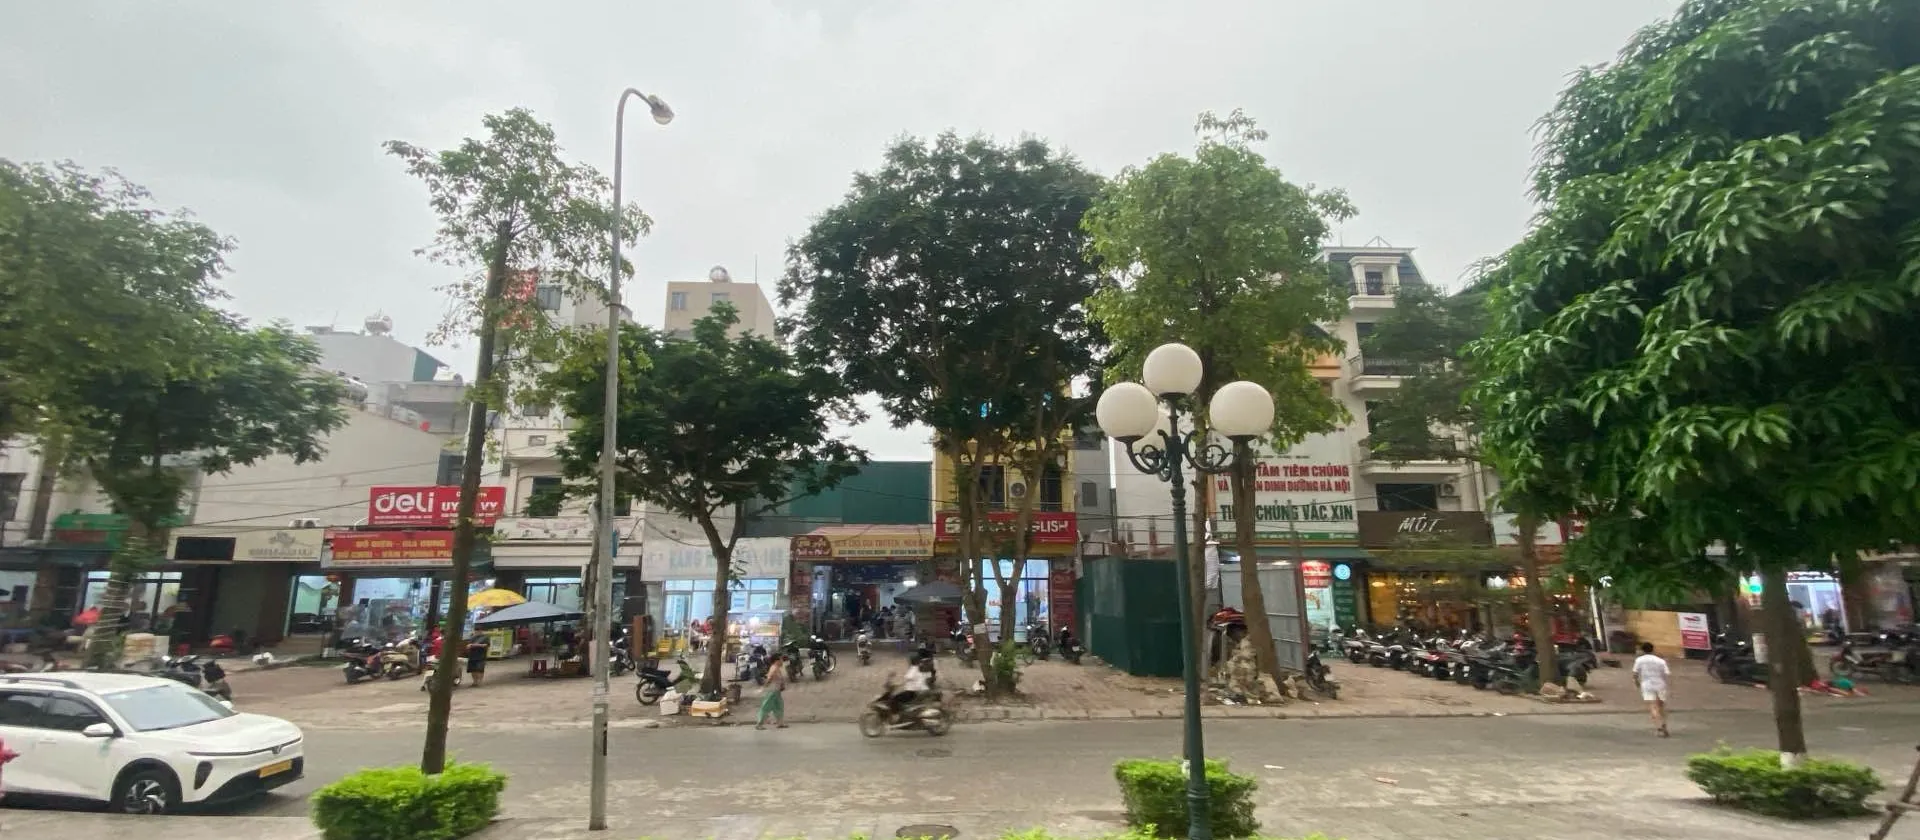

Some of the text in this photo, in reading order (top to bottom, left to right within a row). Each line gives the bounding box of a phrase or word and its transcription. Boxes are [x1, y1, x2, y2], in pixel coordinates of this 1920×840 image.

[1257, 462, 1350, 477] TÂM TIÊM CHỦNG
[1320, 479, 1333, 492] HÀ
[1334, 479, 1351, 493] NỘI
[375, 492, 435, 513] deli
[480, 501, 499, 511] VY
[1255, 500, 1299, 520] CHỦNG
[1302, 499, 1328, 520] VẮC
[1330, 504, 1354, 520] XIN
